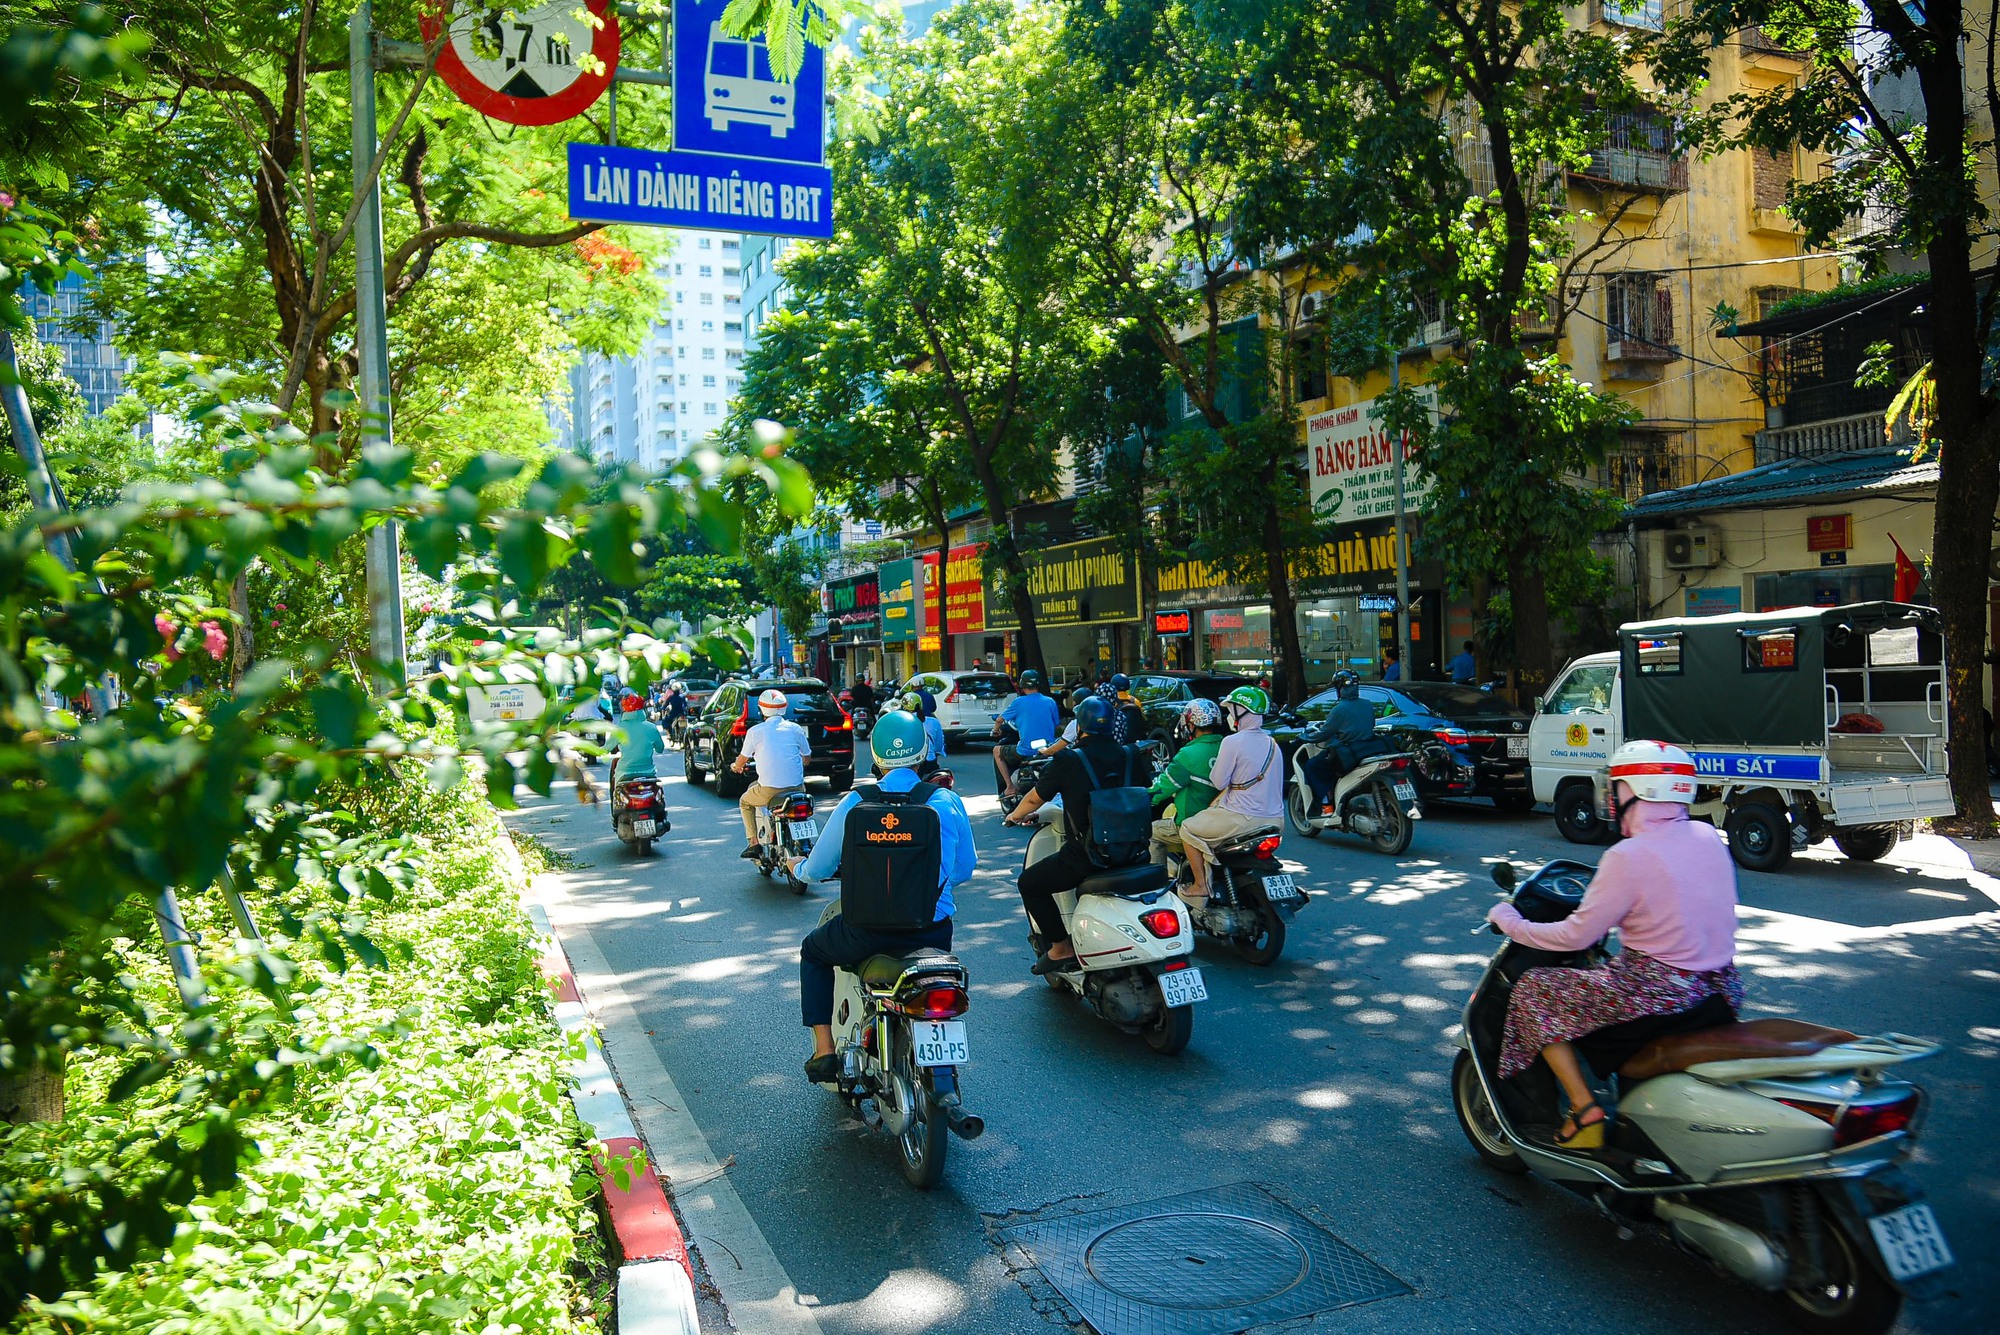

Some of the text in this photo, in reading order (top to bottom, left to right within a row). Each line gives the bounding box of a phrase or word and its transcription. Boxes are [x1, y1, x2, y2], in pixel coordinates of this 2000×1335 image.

[583, 156, 822, 223] LÀN DÀNH RIÊNG BRT
[1310, 414, 1334, 432] PHÒNG
[1335, 407, 1358, 424] KHÁM
[1314, 435, 1356, 477] RĂNG
[1357, 425, 1392, 468] HÀM
[1338, 531, 1369, 574] HÀ
[1369, 526, 1412, 576] NỘI
[1046, 561, 1066, 594] CAY
[1065, 550, 1084, 591] HẢI
[1085, 548, 1125, 588] PHÒNG
[1236, 693, 1253, 704] Grab
[885, 746, 914, 758] Casper
[1550, 749, 1568, 758] CÔNG
[1579, 749, 1607, 759] PHƯỜNG
[1736, 755, 1777, 774] SÁT
[866, 831, 912, 843] laptop88
[1165, 971, 1197, 990] 29-G1
[1166, 984, 1205, 1004] 997.85
[931, 1023, 946, 1041] 31
[918, 1042, 966, 1061] 430-P5
